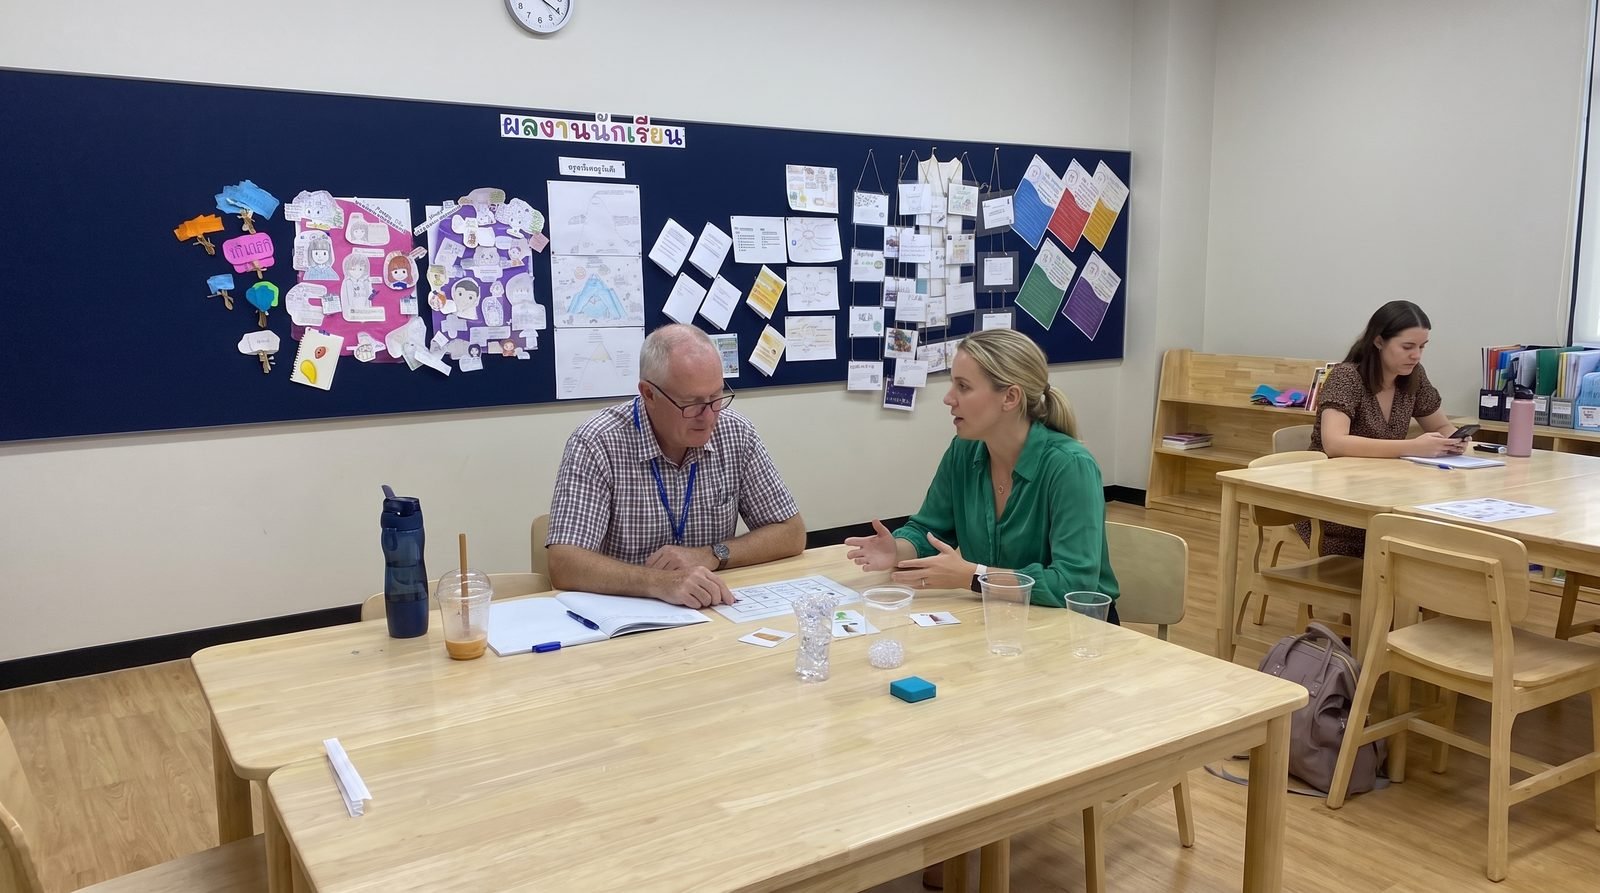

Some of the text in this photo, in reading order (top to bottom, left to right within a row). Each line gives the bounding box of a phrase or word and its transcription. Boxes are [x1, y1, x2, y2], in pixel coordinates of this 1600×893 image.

[518, 2, 523, 10] 8
[526, 11, 531, 19] 7
[537, 16, 543, 24] 6
[503, 113, 682, 145] ผลงานนักเรียน
